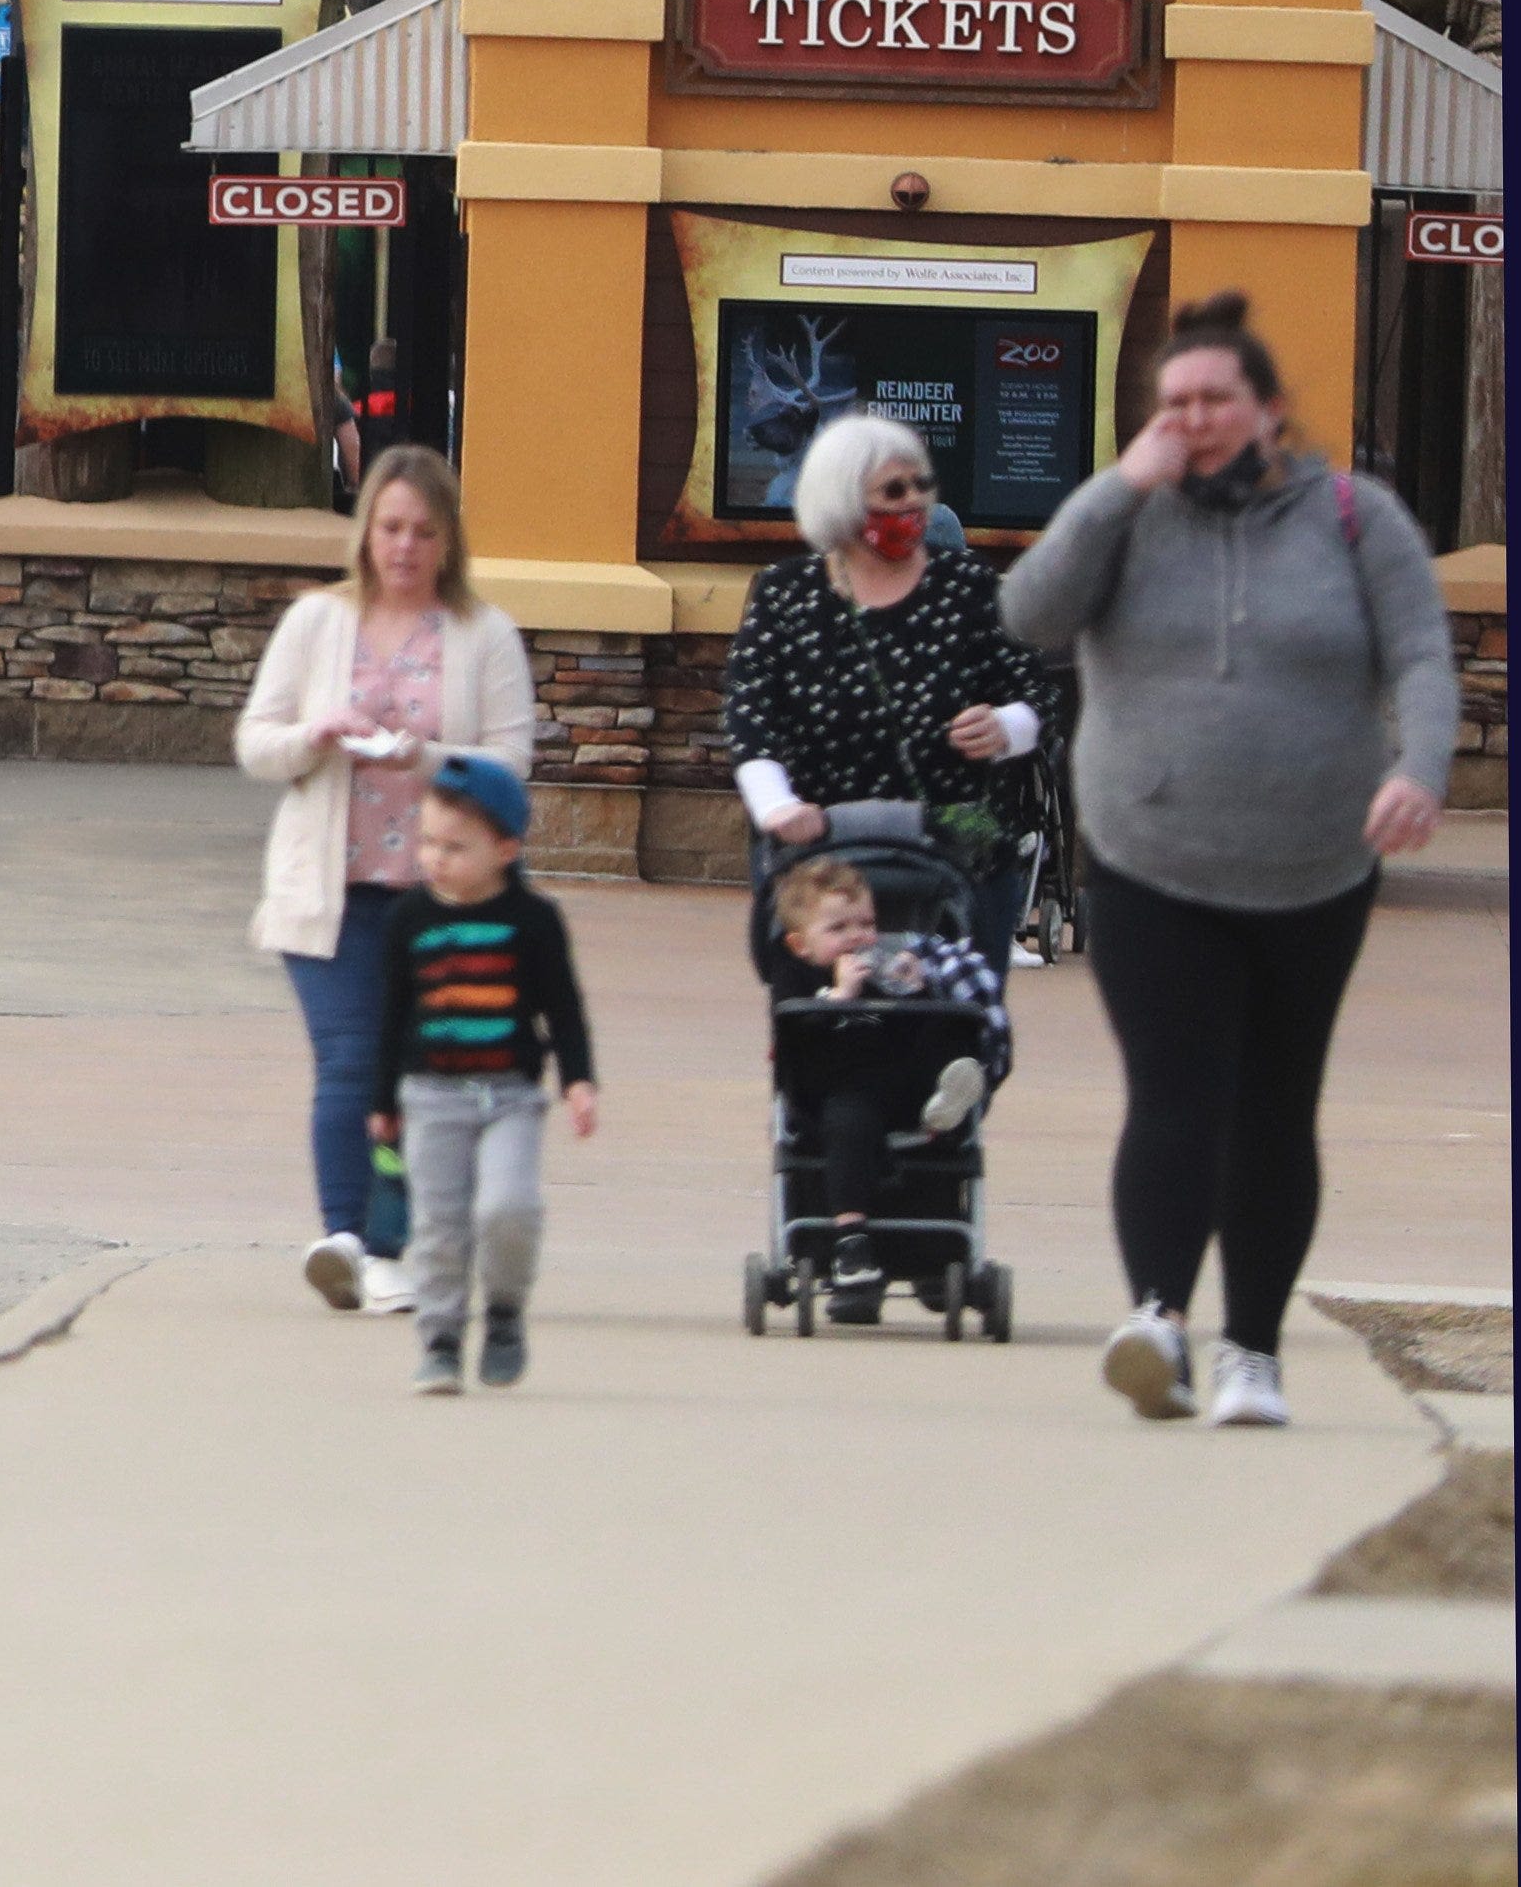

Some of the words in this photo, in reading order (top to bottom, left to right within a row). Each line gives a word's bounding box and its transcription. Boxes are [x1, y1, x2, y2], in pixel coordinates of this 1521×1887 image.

[220, 183, 396, 221] CLOSED
[904, 267, 938, 280] Wolfe
[997, 338, 1061, 368] ZOO
[876, 379, 955, 402] REINDEER
[867, 400, 963, 423] ENCOUNTER
